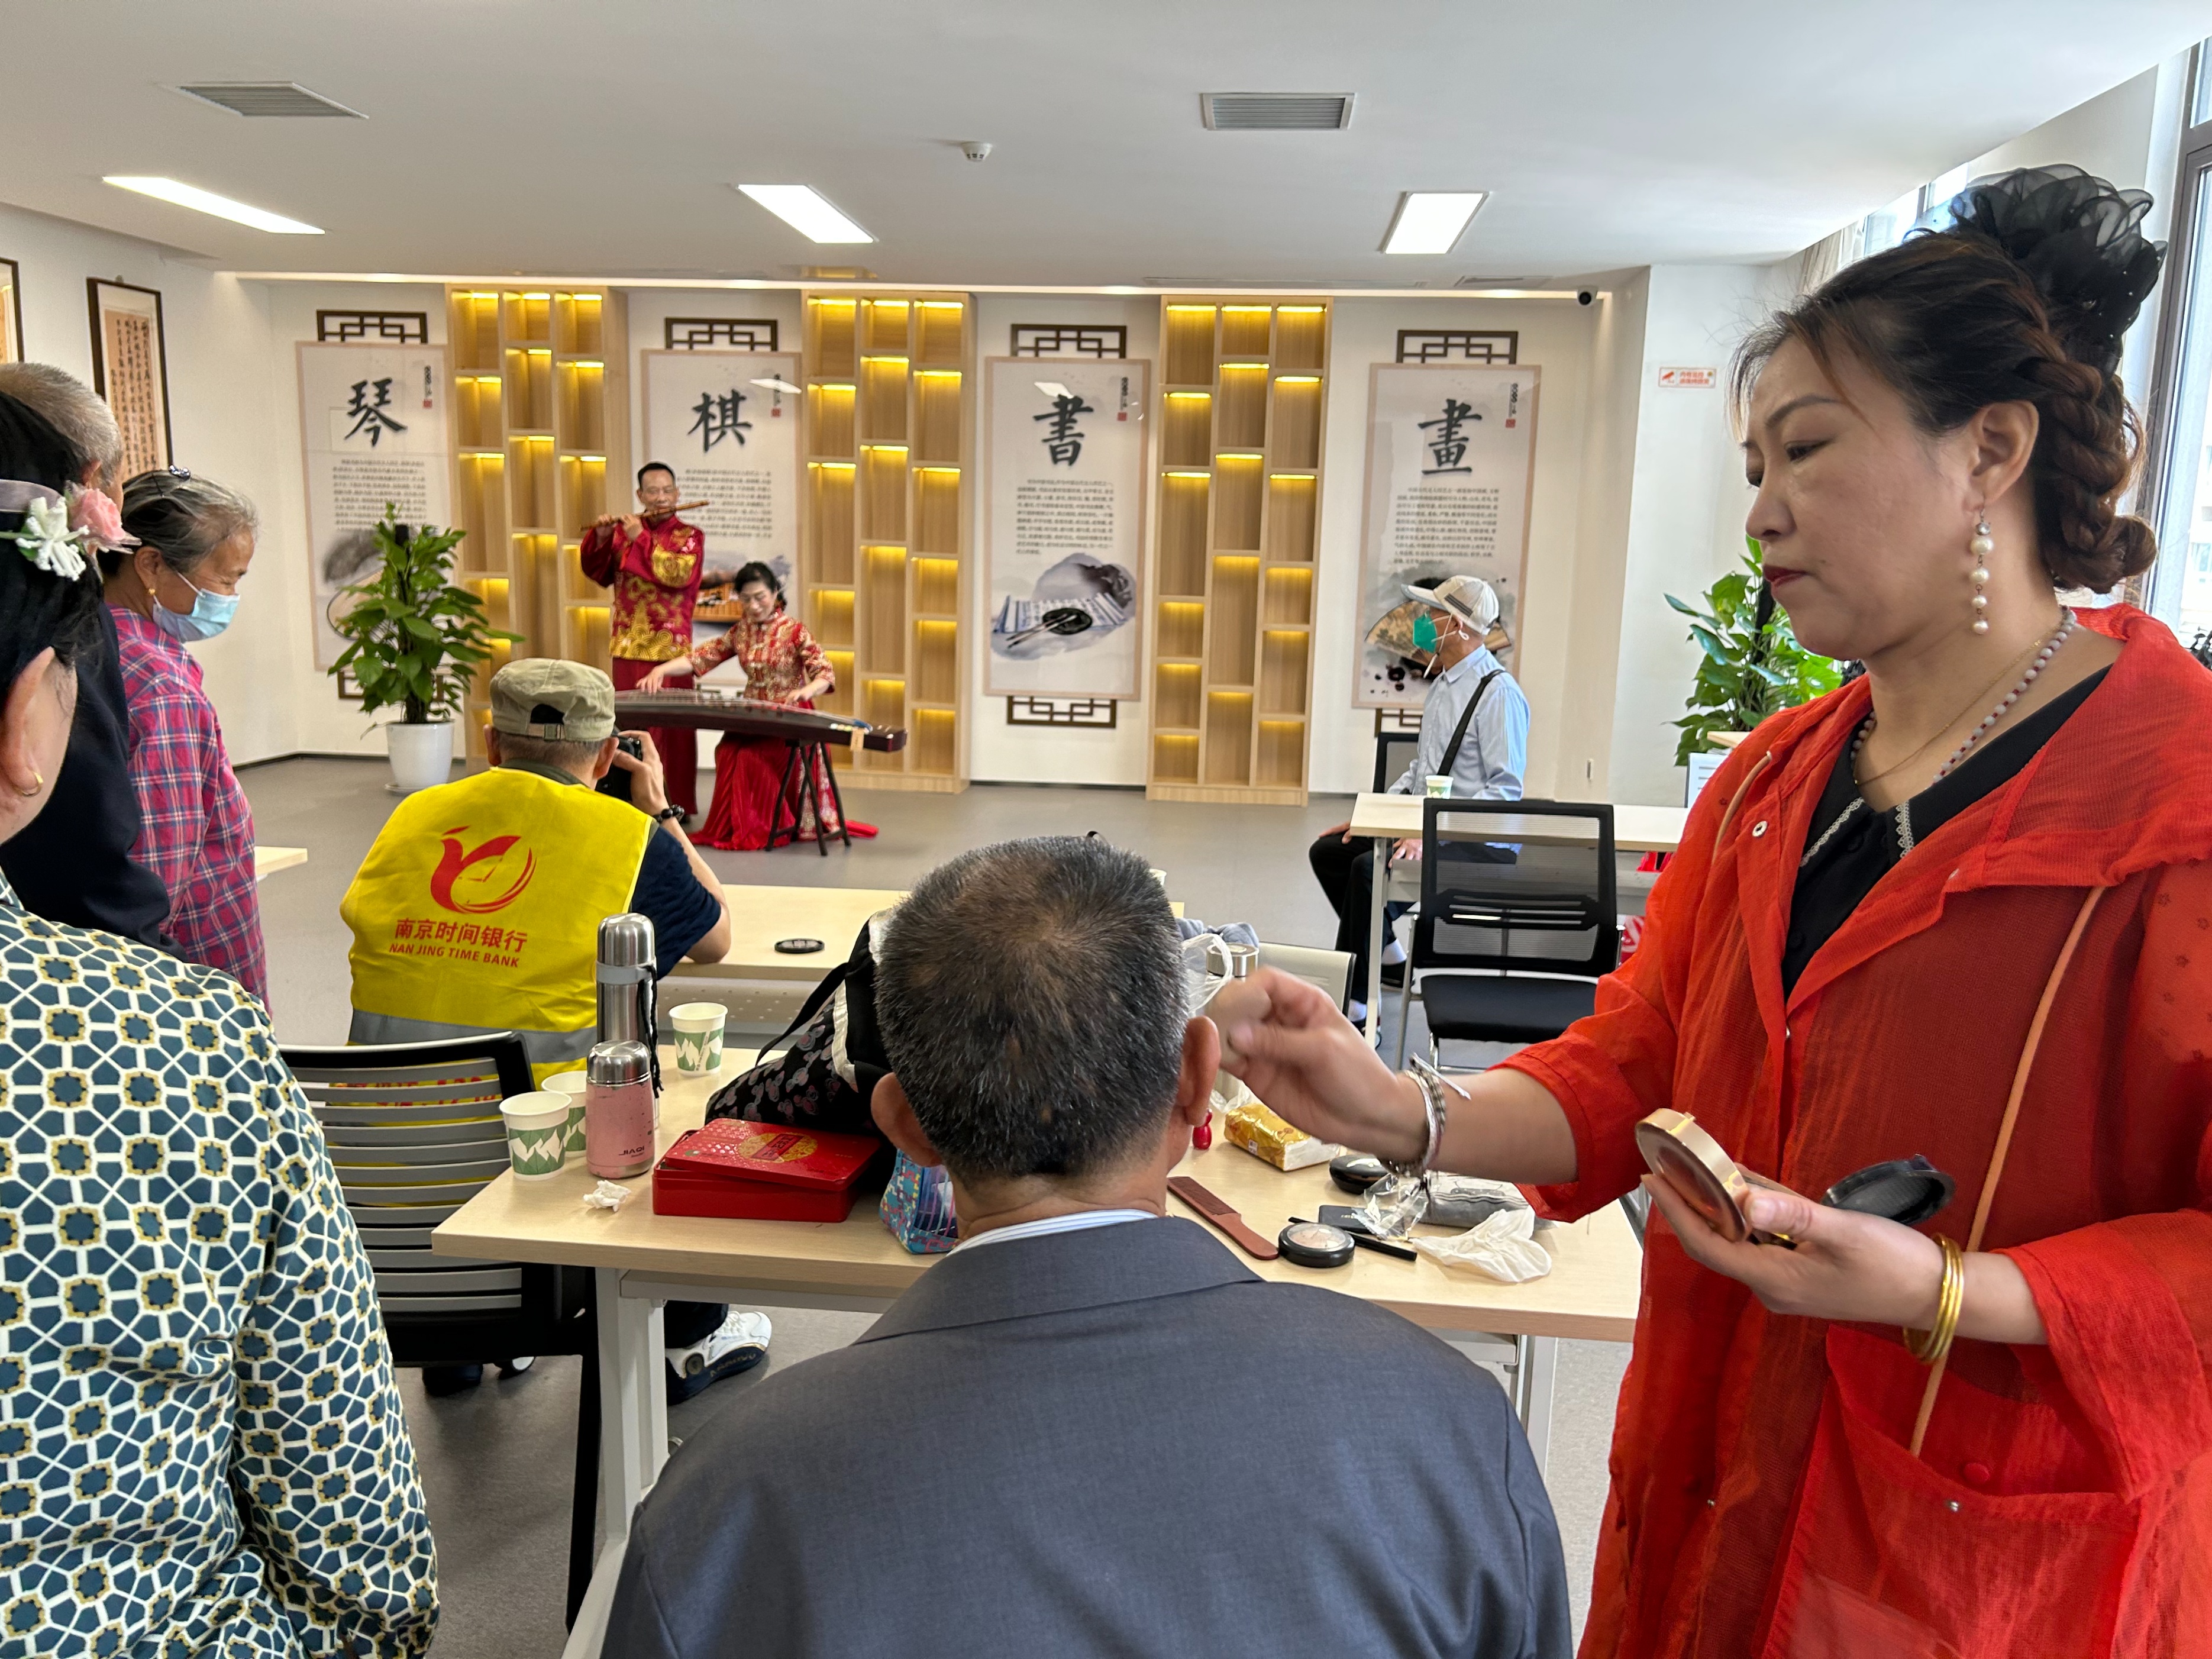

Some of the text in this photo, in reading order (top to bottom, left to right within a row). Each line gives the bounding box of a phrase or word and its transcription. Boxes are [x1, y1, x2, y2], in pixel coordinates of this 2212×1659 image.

[345, 377, 407, 447] 琴
[687, 389, 753, 453] 棋
[1034, 393, 1094, 467] 書
[1418, 398, 1482, 475] 畫
[389, 943, 519, 968] NAN JING TIME BANK
[395, 918, 528, 953] 南京时间银行
[619, 1145, 645, 1156] JIAQI
